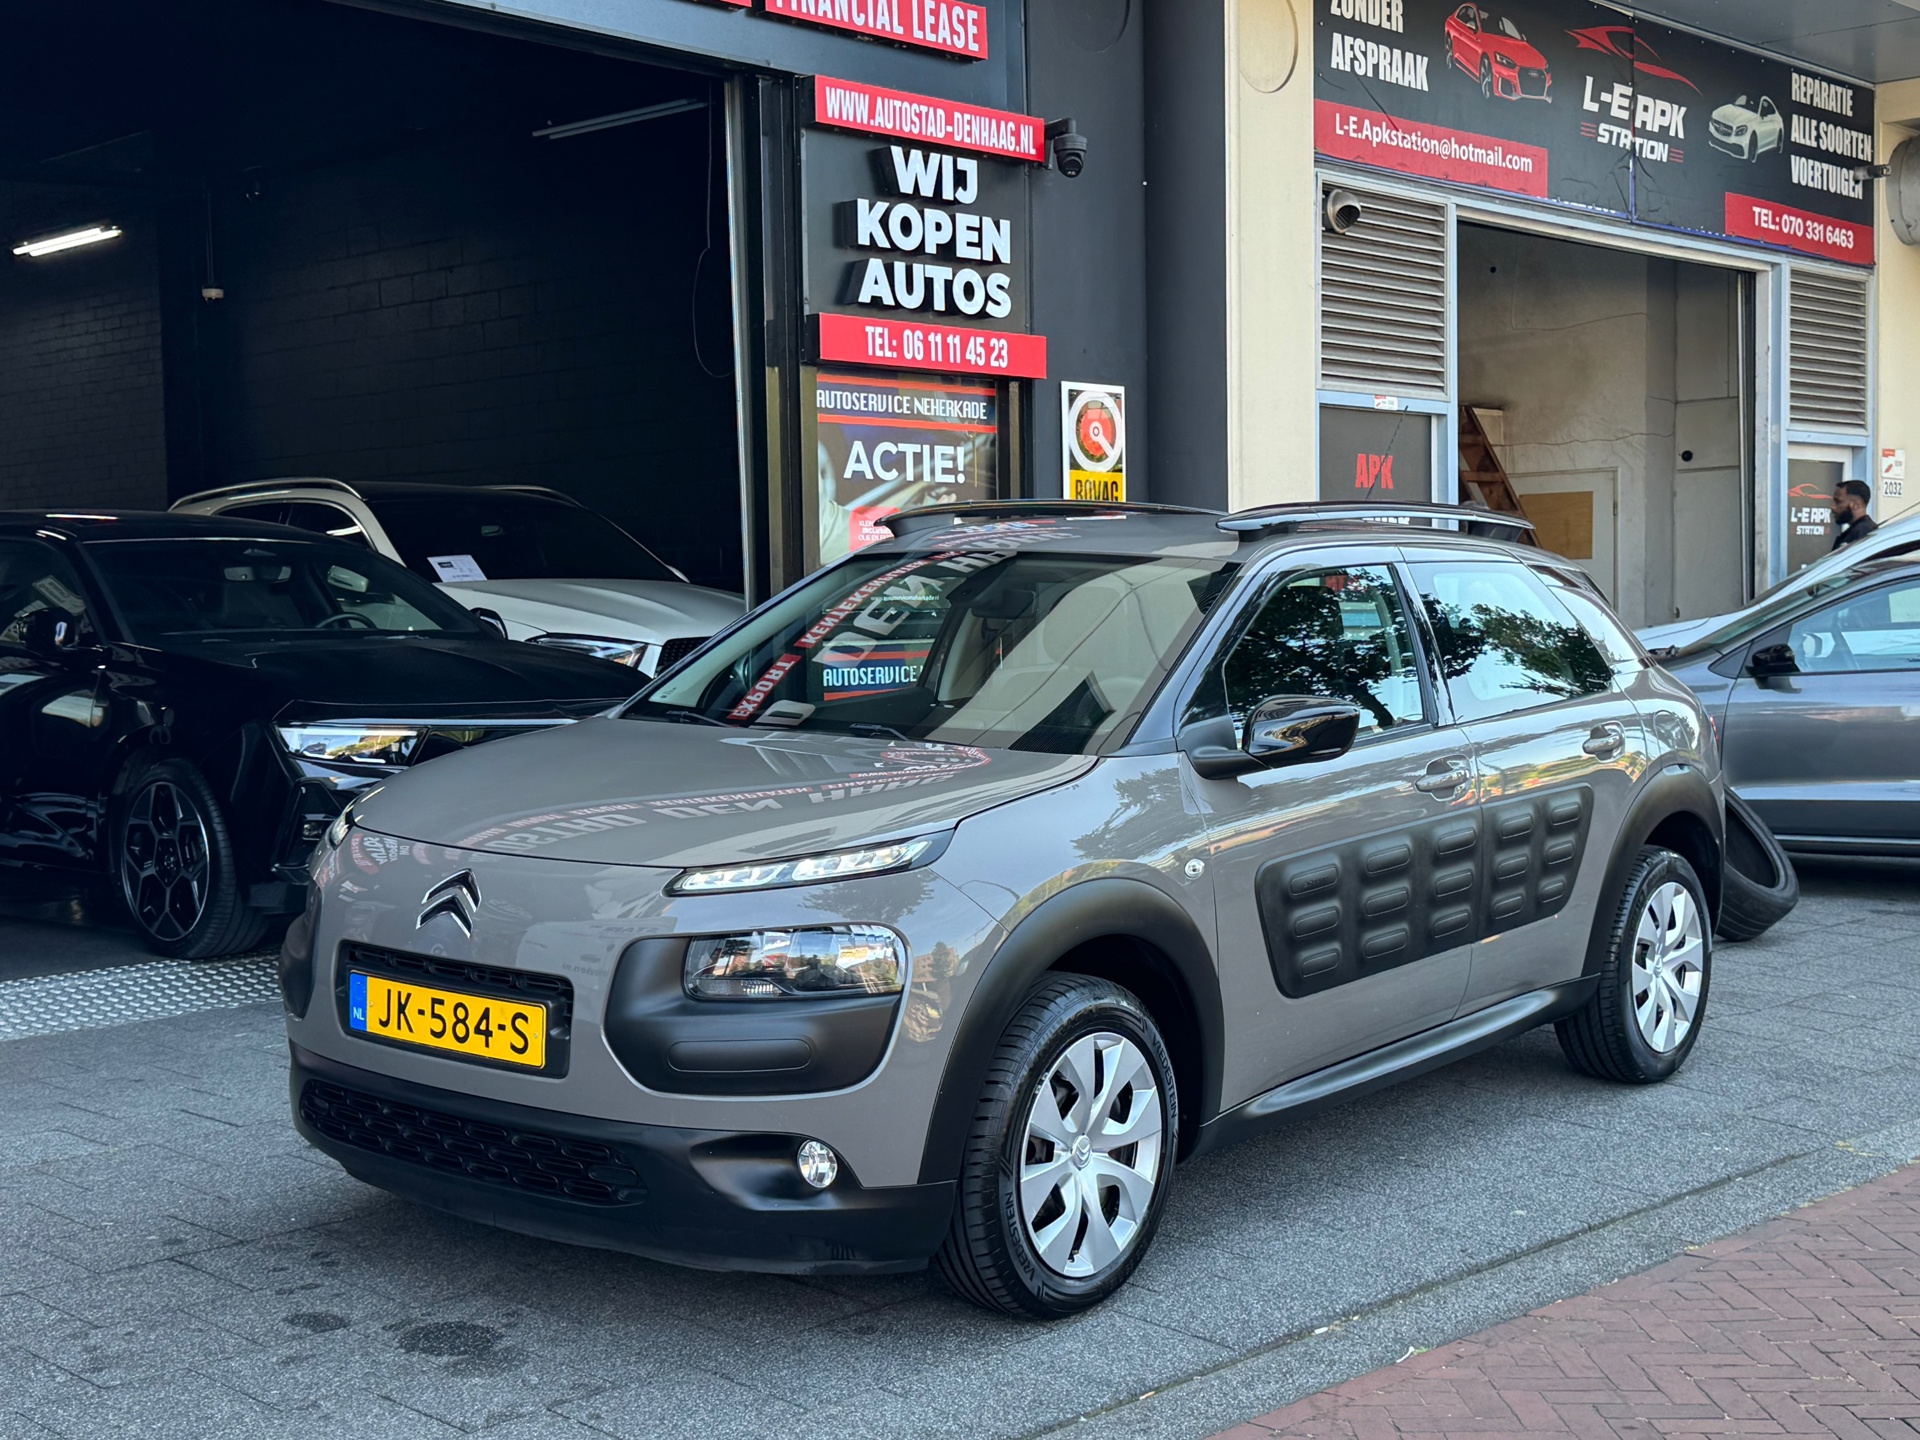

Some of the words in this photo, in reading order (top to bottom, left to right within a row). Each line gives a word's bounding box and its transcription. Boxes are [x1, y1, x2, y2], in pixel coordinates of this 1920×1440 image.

[912, 0, 980, 52] LEASE
[1330, 32, 1429, 92] AFSPRAAK
[1583, 75, 1633, 120] L-E
[1634, 94, 1687, 139] APK
[1791, 72, 1853, 117] REPARATIE
[825, 86, 1036, 155] WWW.AUTOSTAD-DENHAAG.NL
[1335, 112, 1533, 173] L-E.Apkstation@hotmail.com
[1597, 122, 1669, 163] STATION
[1790, 114, 1818, 148] ALLE
[1819, 121, 1872, 162] SOORTEN
[890, 145, 978, 205] WIJ
[857, 197, 1011, 264] KOPEN
[1752, 206, 1779, 231] TEL:
[1781, 214, 1804, 237] 070
[1805, 220, 1824, 242] 331
[1825, 225, 1854, 249] 6463
[858, 257, 1012, 318] AUTOS
[865, 325, 897, 358] TEL:
[903, 329, 924, 361] 06
[928, 332, 943, 362] 11
[947, 334, 961, 364] 11
[965, 336, 986, 367] 45
[990, 338, 1009, 368] 23
[816, 390, 911, 414] AUTOSERVICE
[914, 397, 987, 420] NEHERKADE
[843, 440, 966, 484] ACTIE!
[1355, 453, 1394, 489] APK
[1075, 479, 1119, 502] BOVAG
[1884, 482, 1902, 495] 2032
[1796, 526, 1824, 535] STATION
[823, 665, 918, 688] AUTOSERVICE
[353, 1007, 365, 1021] NL
[378, 988, 529, 1055] JK-584-S
[1004, 1191, 1036, 1282] VREDESTEIN
